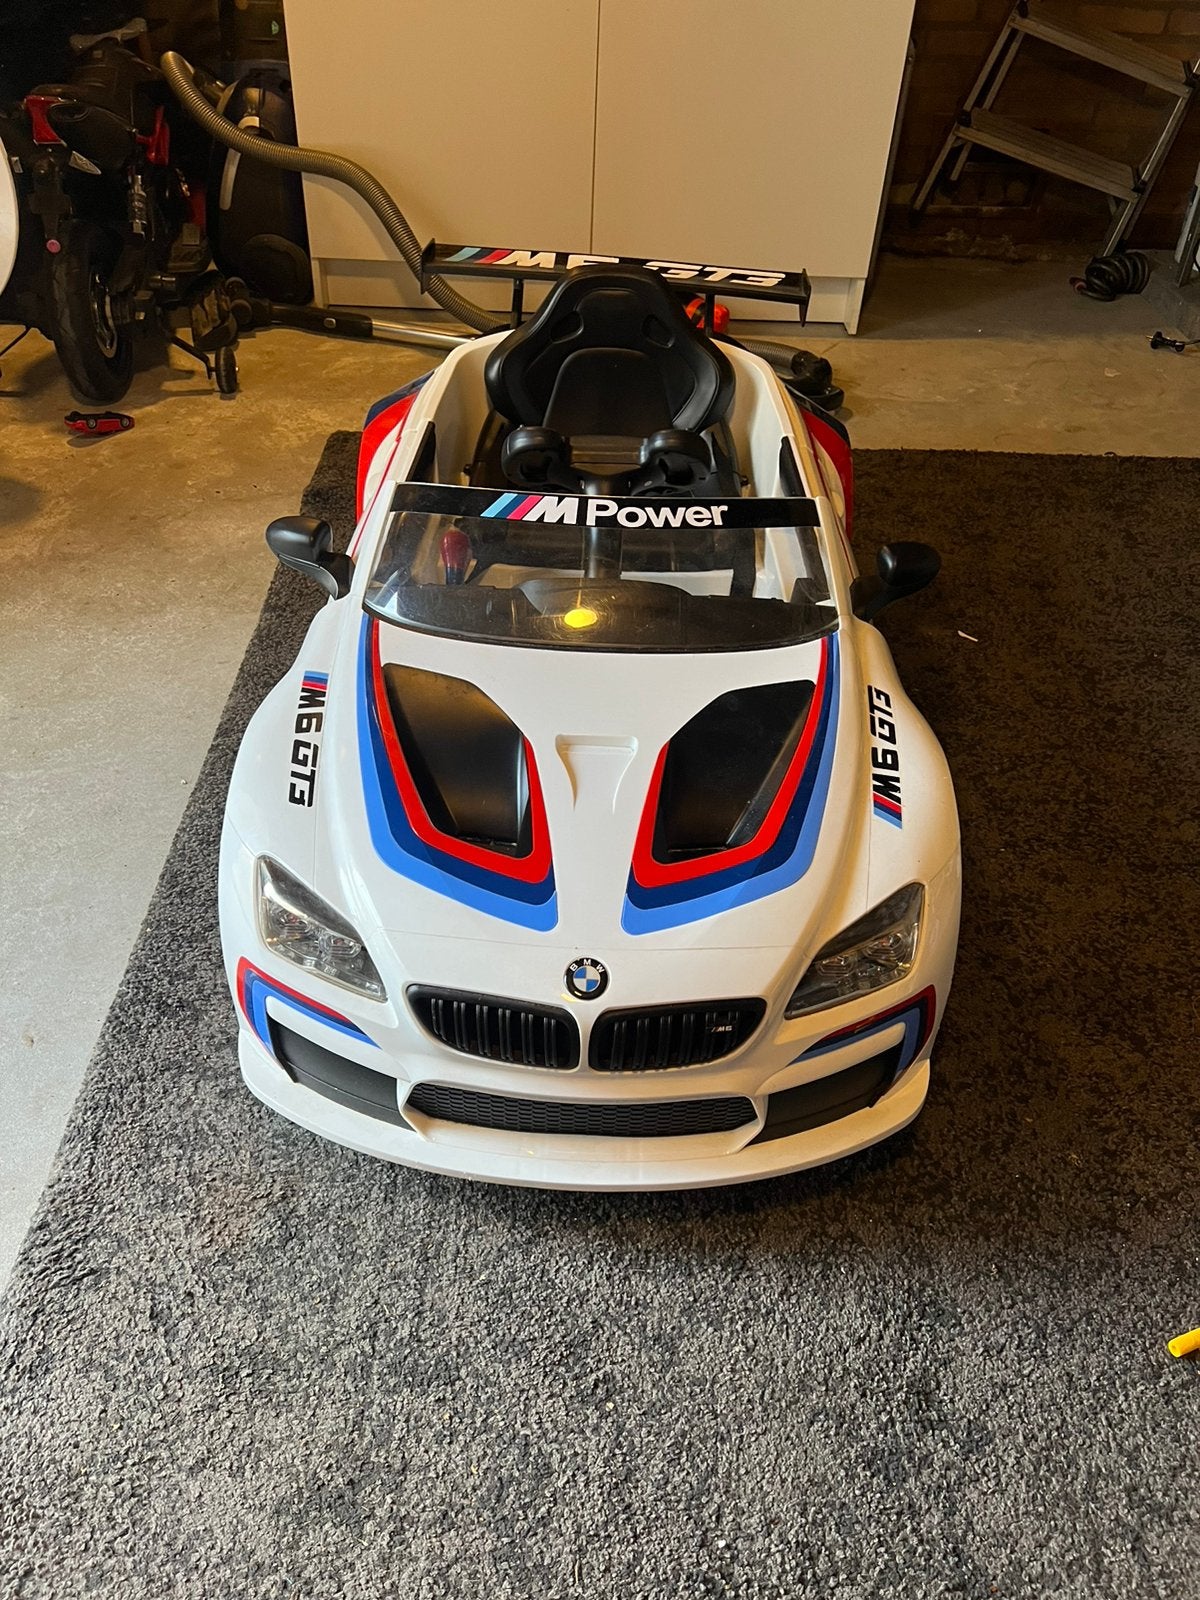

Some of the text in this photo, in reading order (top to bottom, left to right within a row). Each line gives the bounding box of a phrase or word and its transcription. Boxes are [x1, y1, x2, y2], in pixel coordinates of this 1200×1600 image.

[643, 261, 786, 287] GT3
[522, 496, 728, 528] M Power
[288, 687, 327, 808] M6 GT3
[867, 684, 902, 805] M6 GT3
[569, 958, 605, 973] BMW
